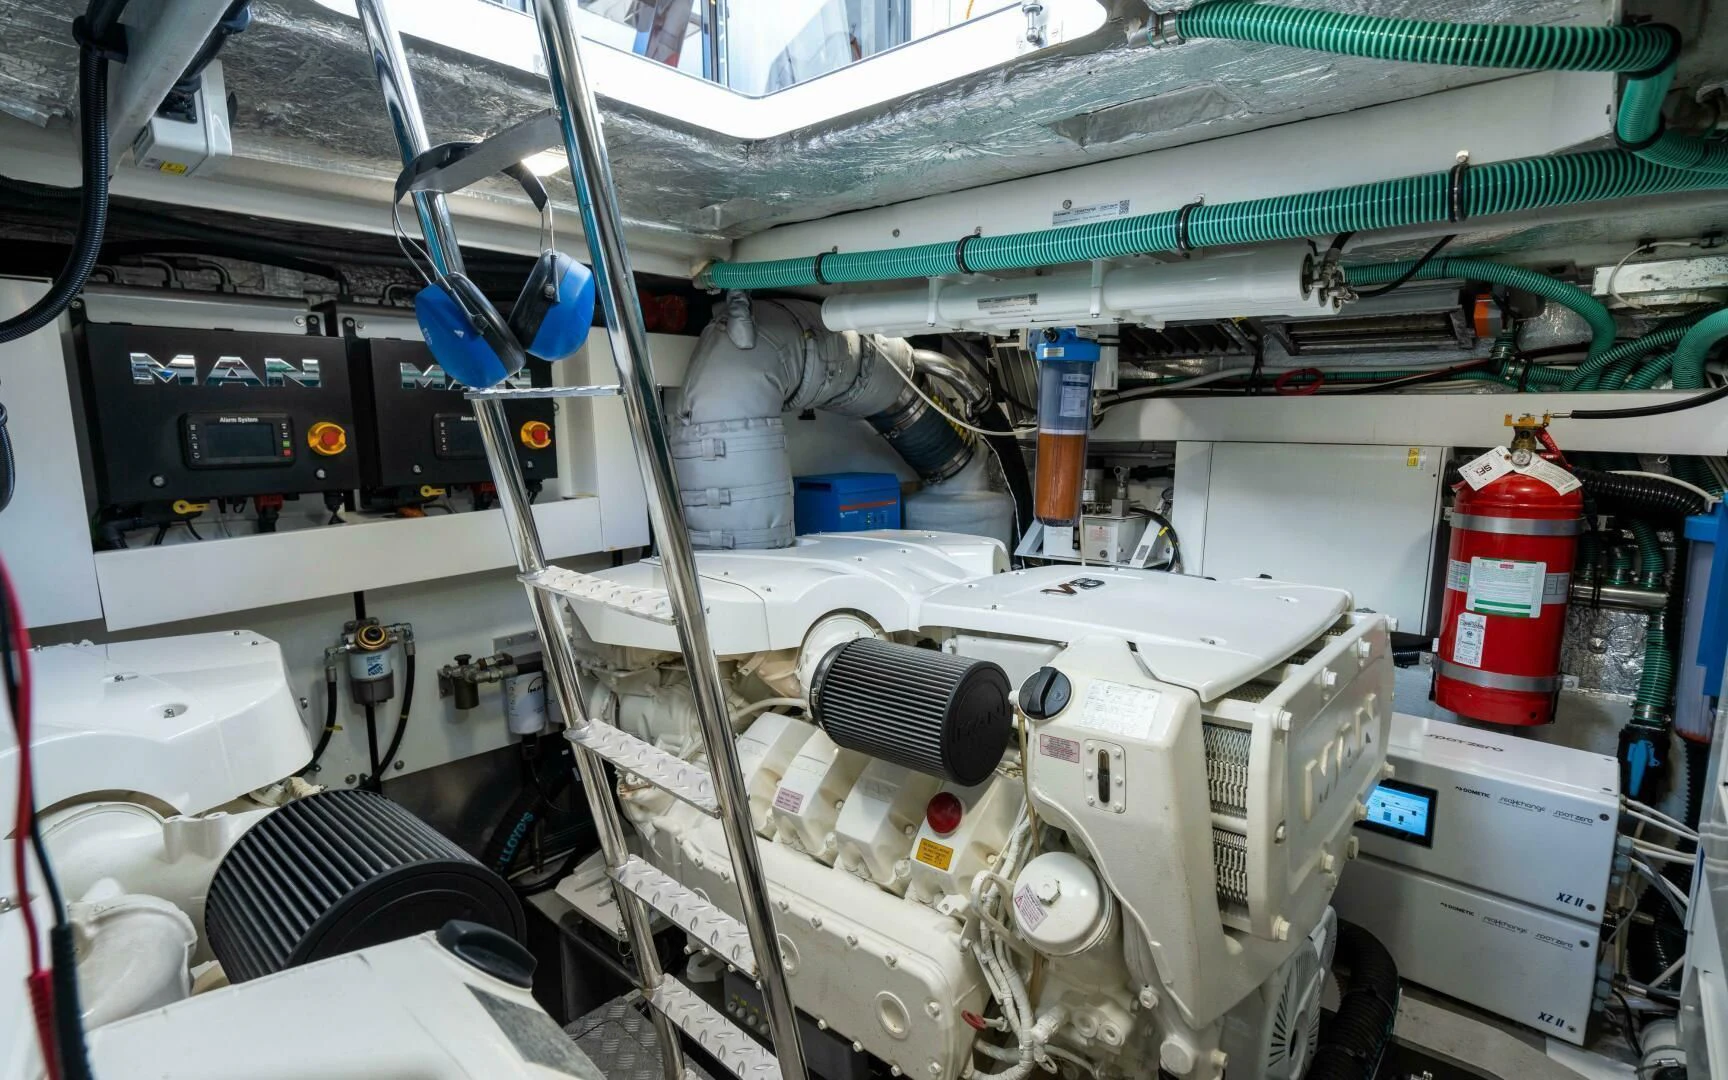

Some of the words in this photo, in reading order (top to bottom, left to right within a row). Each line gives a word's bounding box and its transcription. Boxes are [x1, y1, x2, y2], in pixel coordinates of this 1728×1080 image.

[129, 352, 321, 388] MAN
[400, 362, 532, 390] MN
[238, 416, 259, 424] System
[1463, 788, 1491, 799] DOMETIC
[1556, 892, 1573, 904] XZ
[1537, 1011, 1554, 1024] XZ
